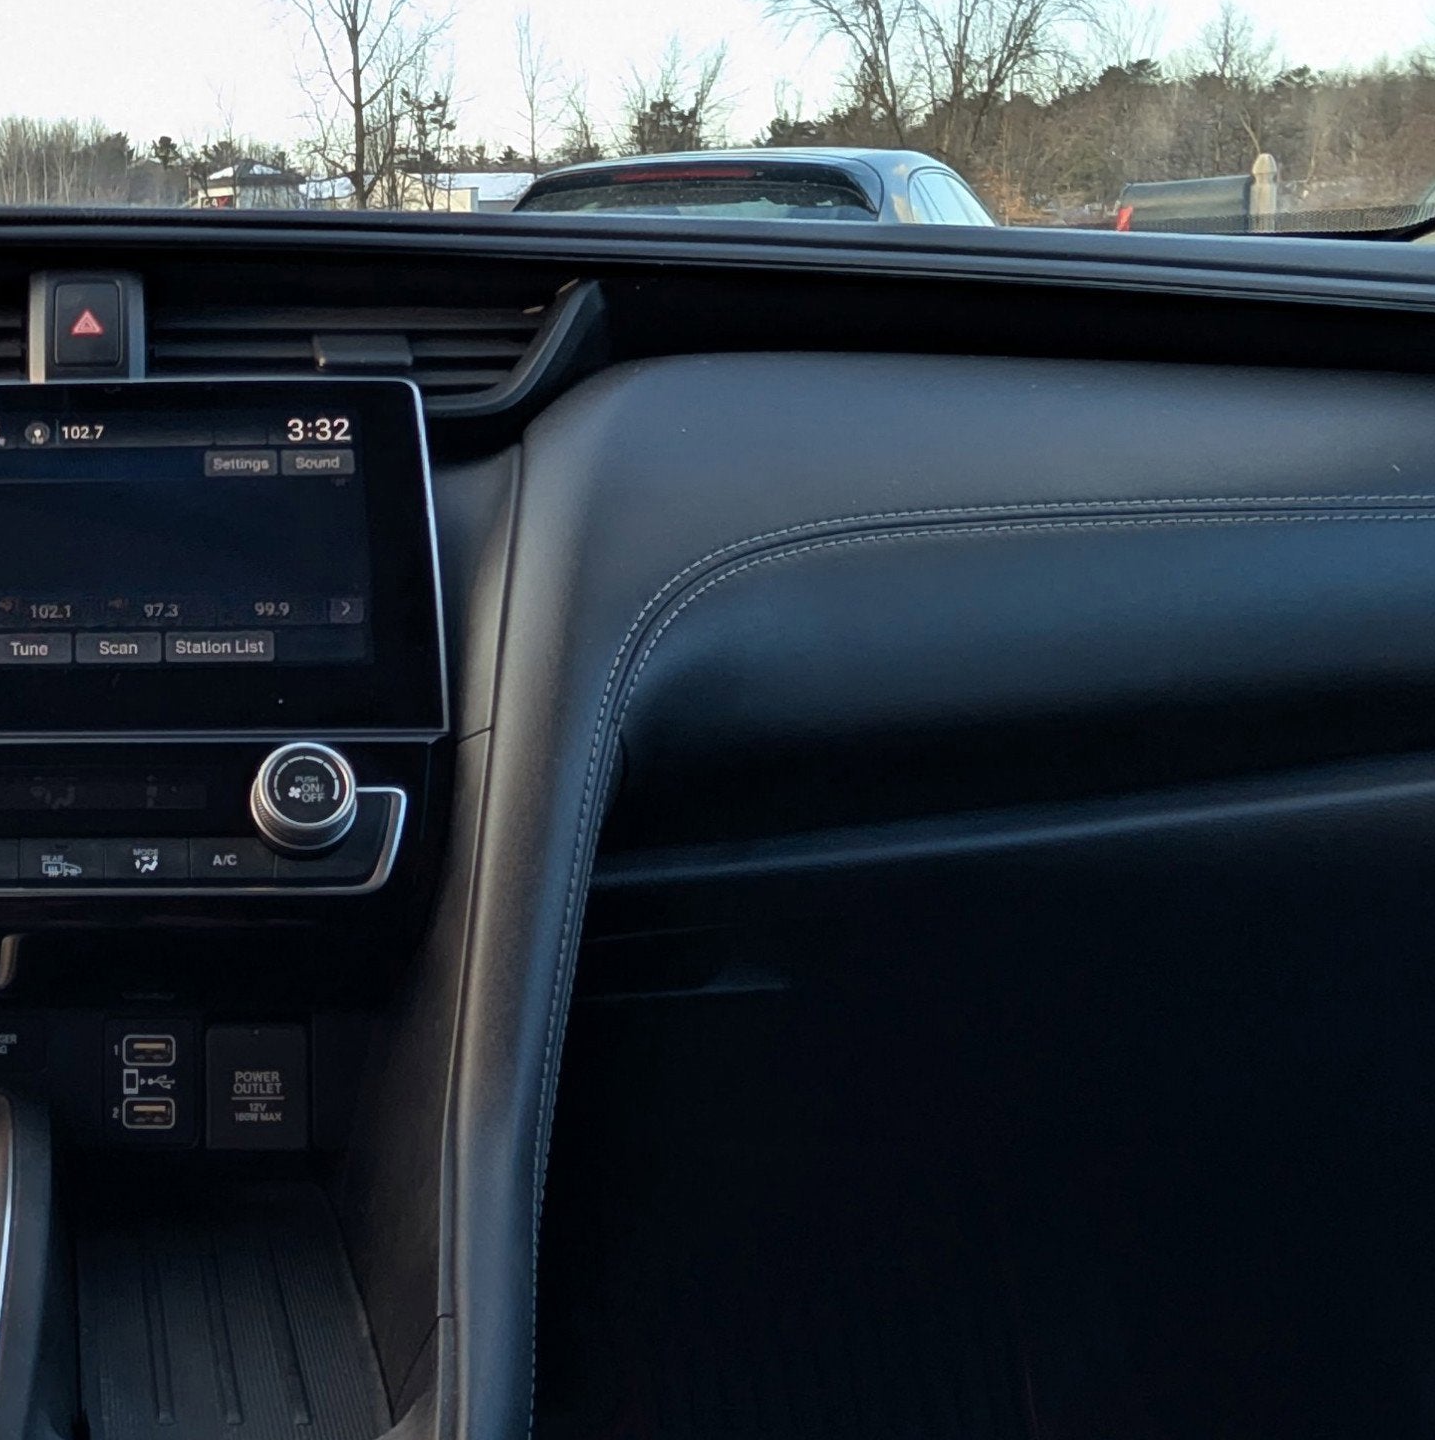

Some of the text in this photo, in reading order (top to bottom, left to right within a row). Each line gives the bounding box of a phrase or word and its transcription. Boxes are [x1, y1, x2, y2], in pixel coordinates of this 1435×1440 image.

[61, 424, 105, 440] 102.7
[287, 417, 353, 442] 3:32
[212, 456, 270, 473] Settings
[294, 455, 341, 470] Sound
[29, 603, 72, 620] 102.1
[142, 602, 180, 618] 97.3
[254, 601, 291, 617] 99.9
[9, 641, 49, 657] Tune
[99, 640, 139, 656] Scan
[175, 638, 265, 655] Station List
[294, 775, 319, 783] PUSH
[300, 783, 326, 794] ON/
[301, 793, 325, 803] OFF
[133, 848, 159, 857] MODE
[212, 854, 238, 866] A/C
[234, 1071, 281, 1083] POWER
[233, 1082, 282, 1095] OUTLET
[249, 1102, 268, 1112] 12V
[260, 1112, 282, 1122] MAX
